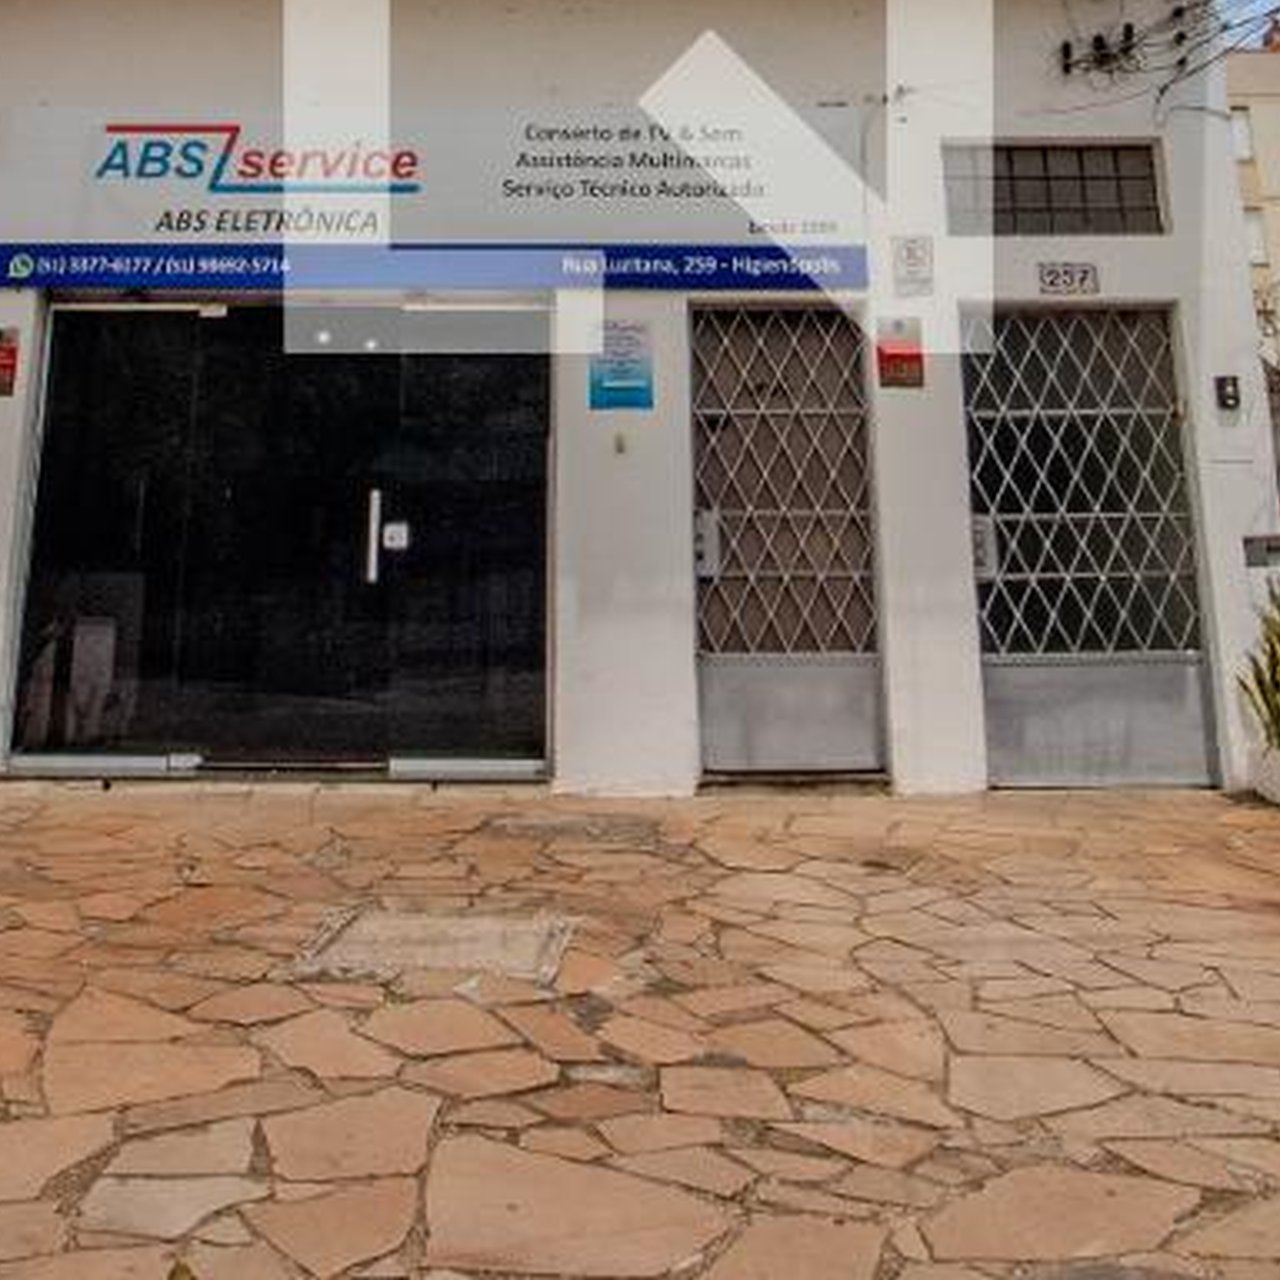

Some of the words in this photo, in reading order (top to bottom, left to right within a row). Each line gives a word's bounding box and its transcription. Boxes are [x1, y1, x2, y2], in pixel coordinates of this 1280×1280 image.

[618, 123, 642, 141] de
[97, 138, 208, 179] ABS
[236, 139, 418, 179] service
[502, 178, 575, 199] Serviço
[155, 209, 206, 232] ABS
[214, 204, 378, 233] ELETRÔNICA
[562, 256, 597, 274] Rua
[682, 255, 718, 274] 259
